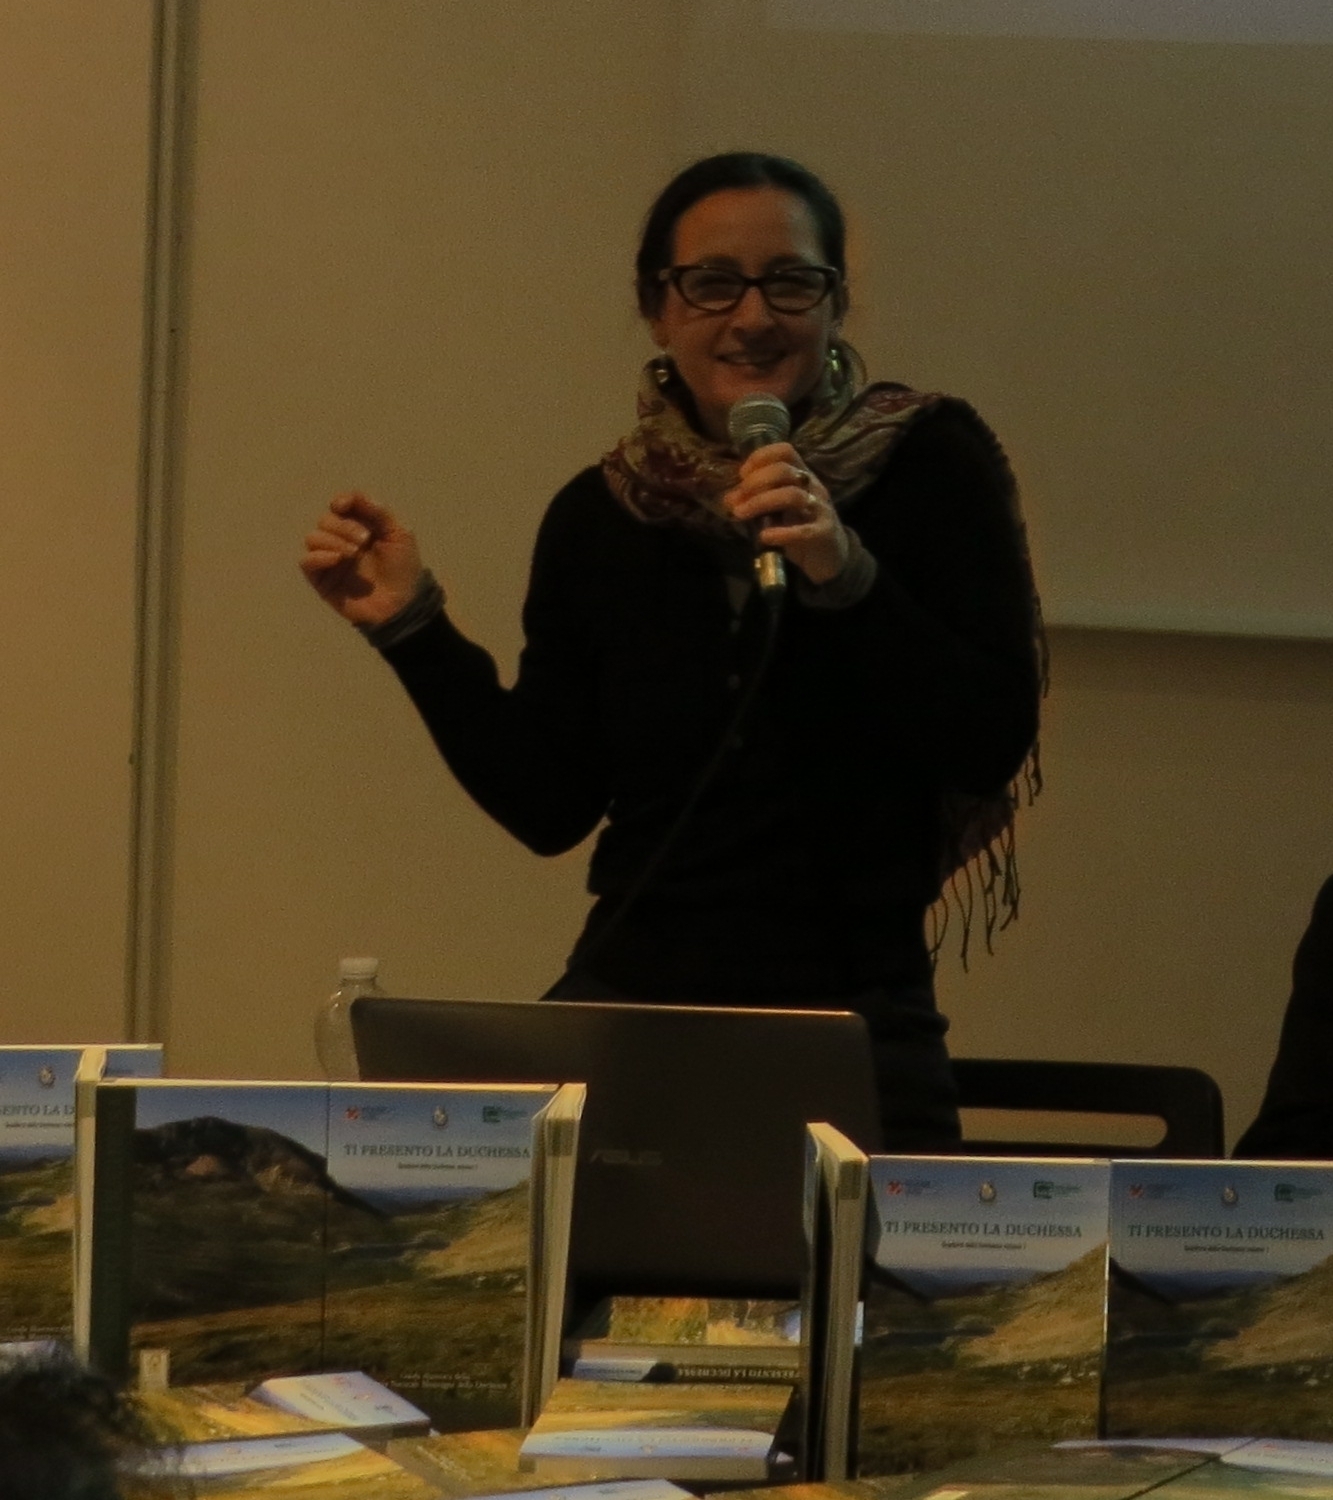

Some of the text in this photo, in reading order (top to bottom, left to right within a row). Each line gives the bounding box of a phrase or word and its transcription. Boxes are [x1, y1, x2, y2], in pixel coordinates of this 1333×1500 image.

[343, 1144, 531, 1159] TI PRESENTO LA DUCHESSA
[884, 1220, 1083, 1238] TI PRESENTO LA DUCHESSA
[1127, 1223, 1325, 1241] TI PRESENTO LA DUCHESSA
